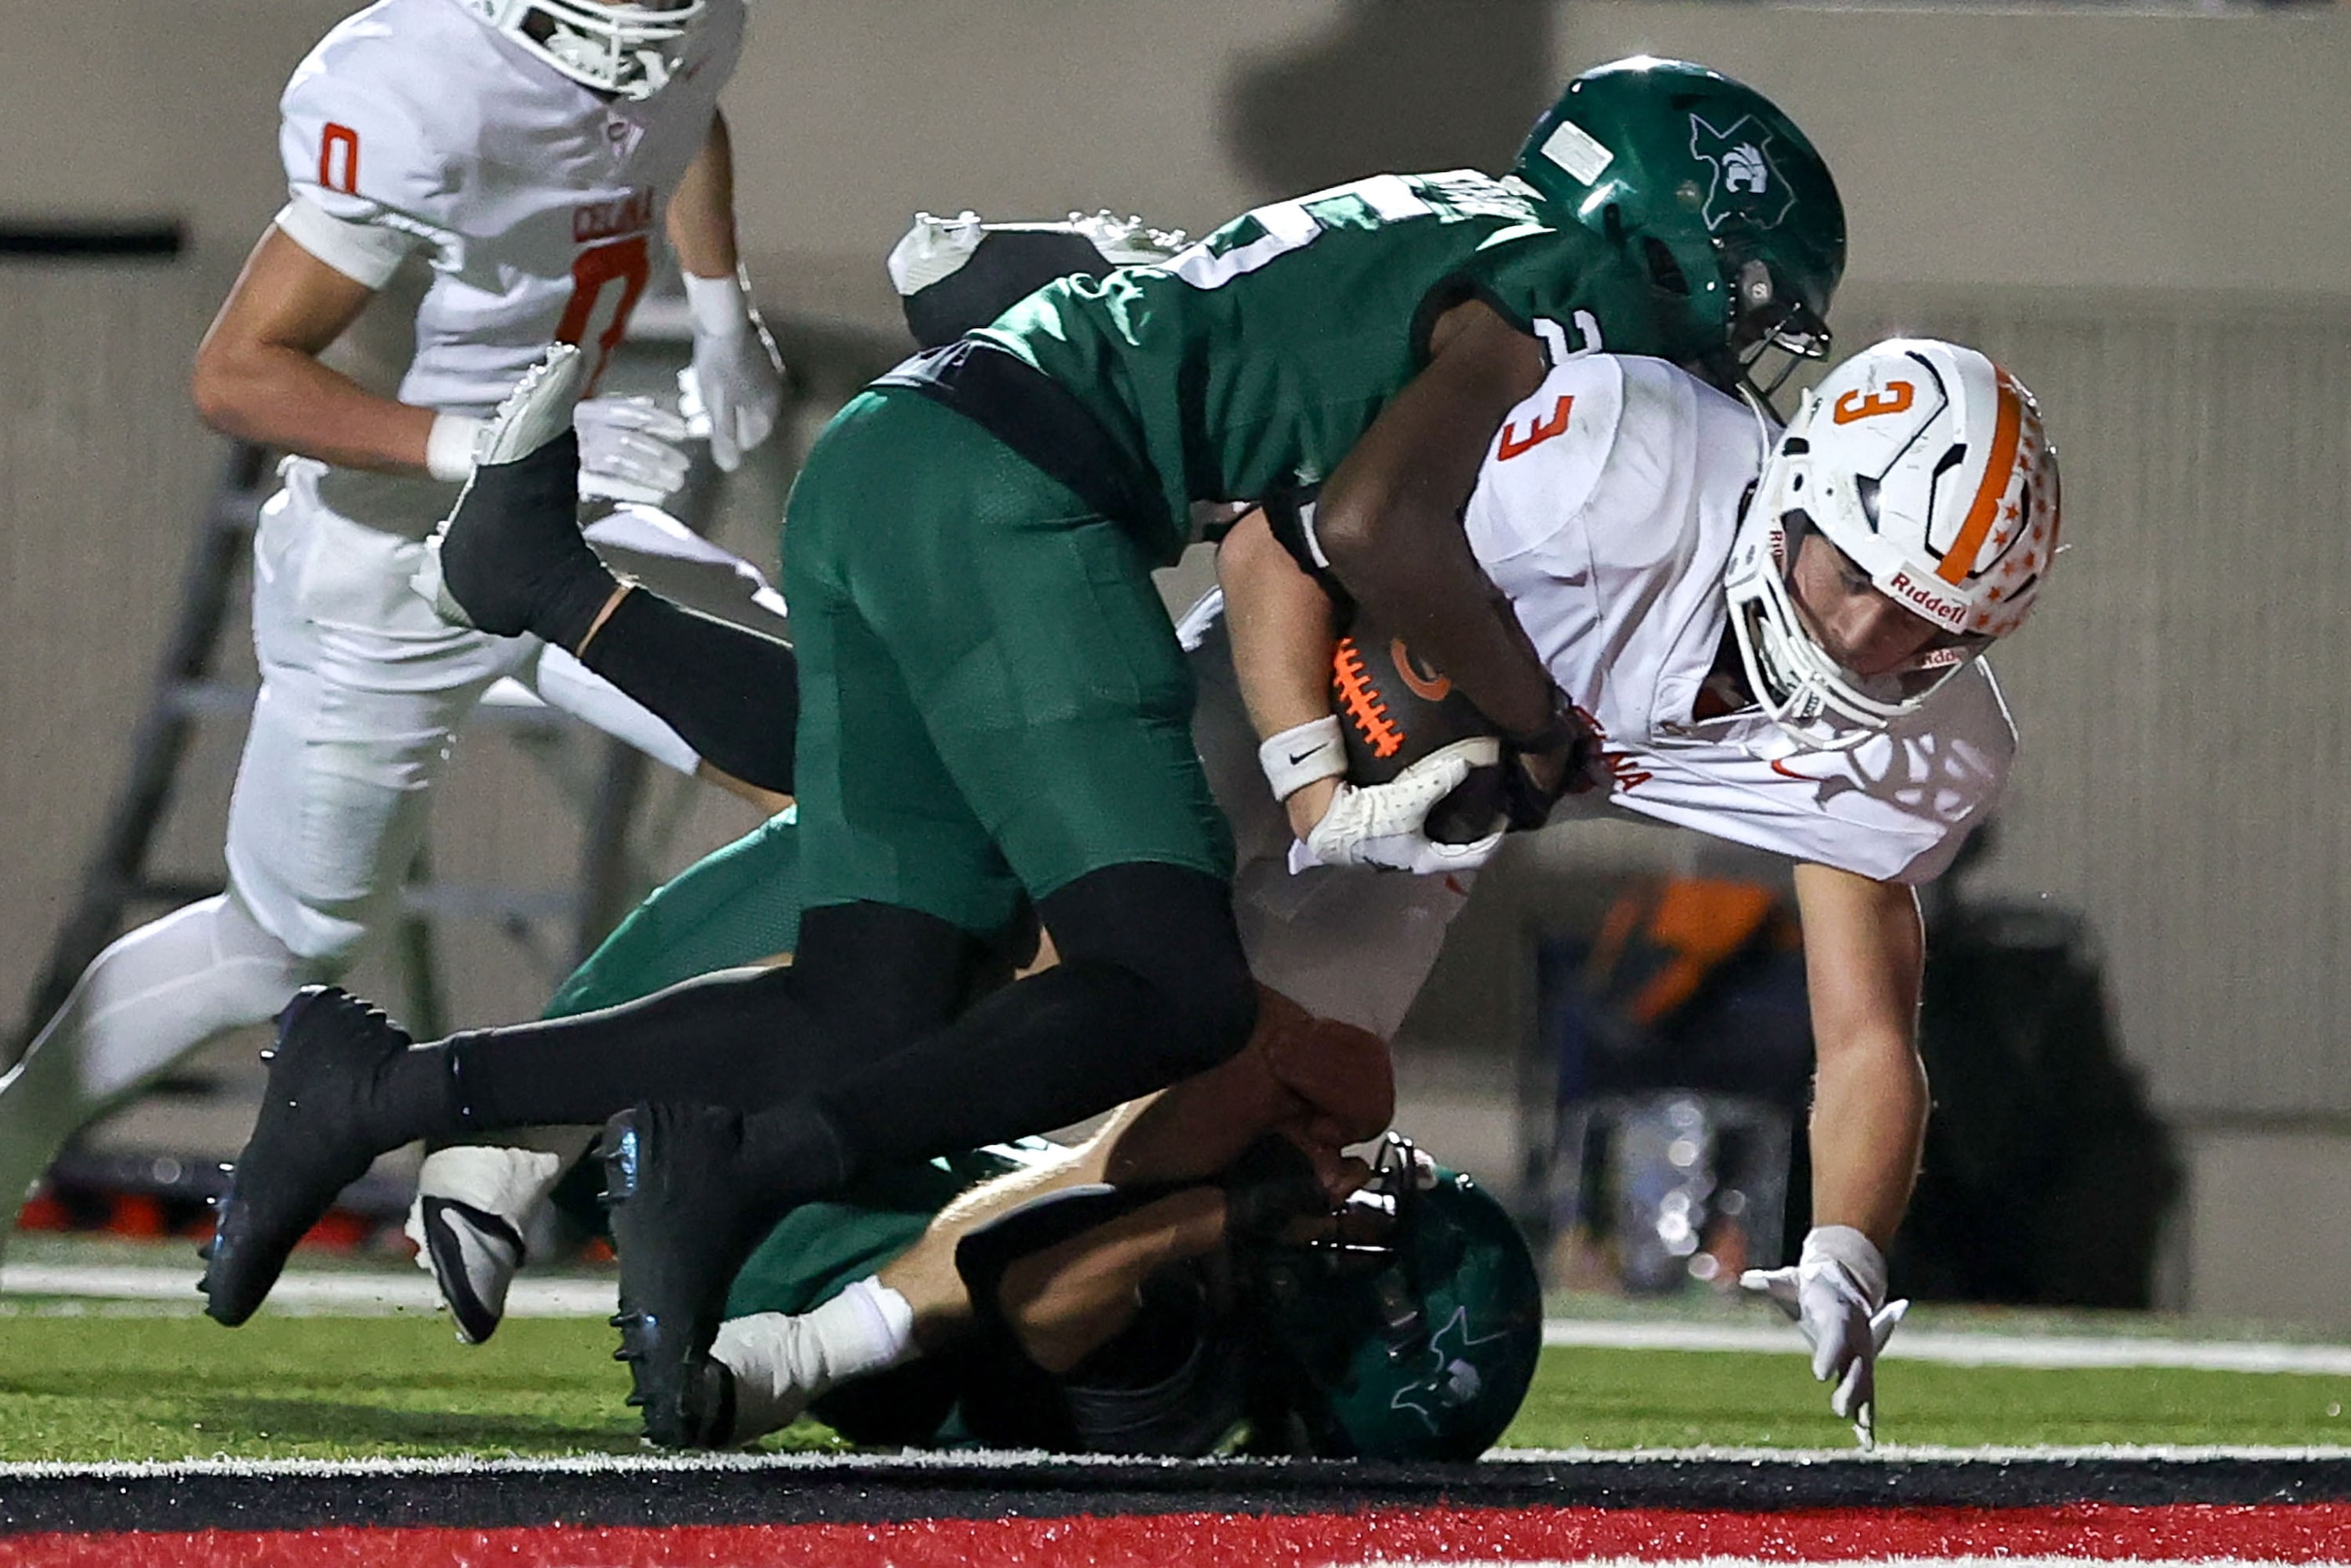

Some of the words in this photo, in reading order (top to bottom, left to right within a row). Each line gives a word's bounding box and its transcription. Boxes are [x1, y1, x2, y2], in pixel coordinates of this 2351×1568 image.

[1497, 395, 1575, 462] 3
[1833, 380, 1915, 426] 3
[1890, 572, 1966, 624] Riddell
